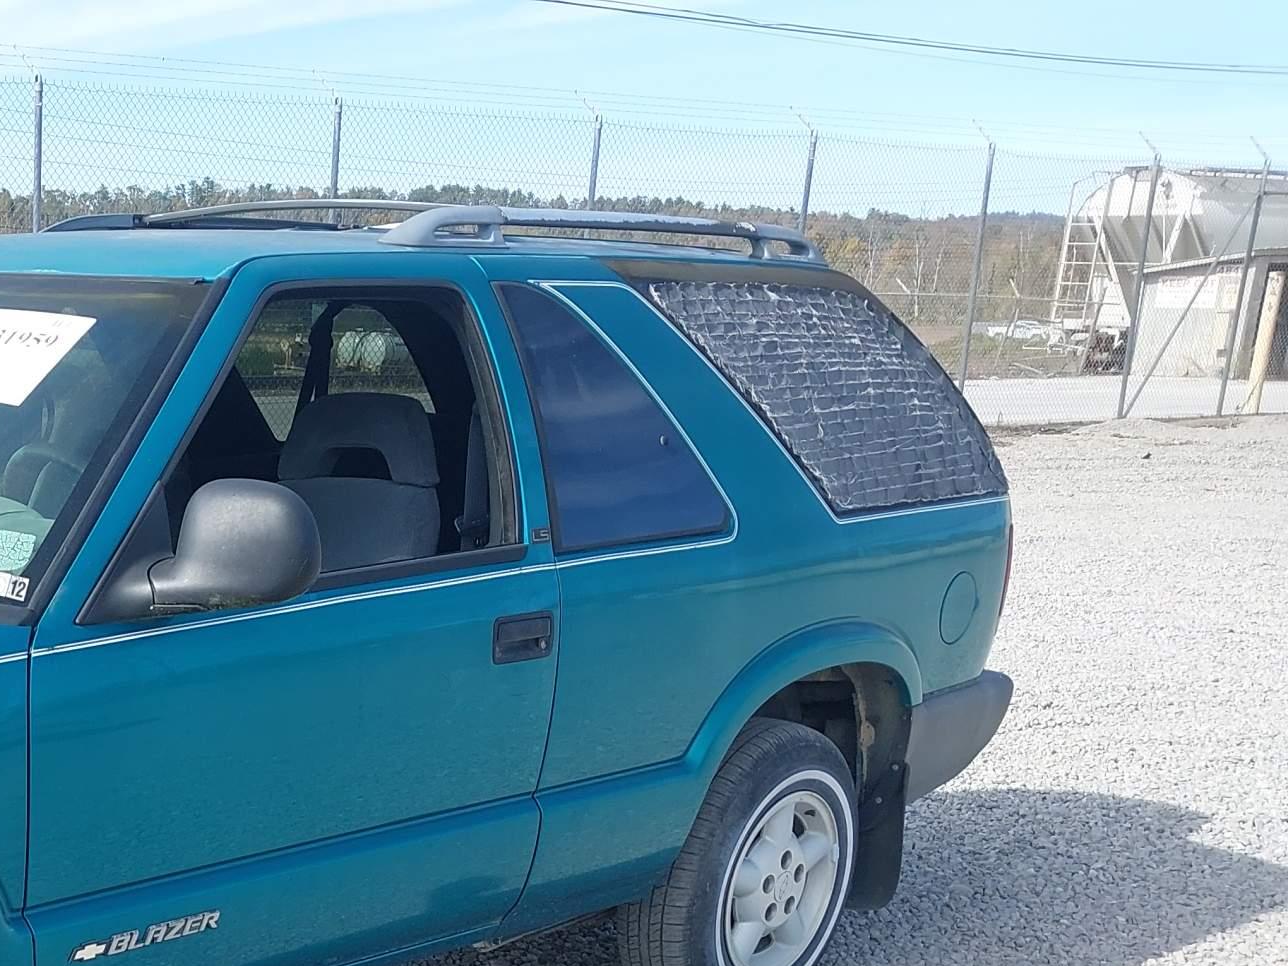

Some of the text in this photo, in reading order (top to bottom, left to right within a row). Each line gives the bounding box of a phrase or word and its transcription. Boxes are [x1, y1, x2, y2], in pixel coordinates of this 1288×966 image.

[532, 529, 550, 542] LS
[11, 579, 26, 598] 12
[107, 910, 221, 956] BLAZER
